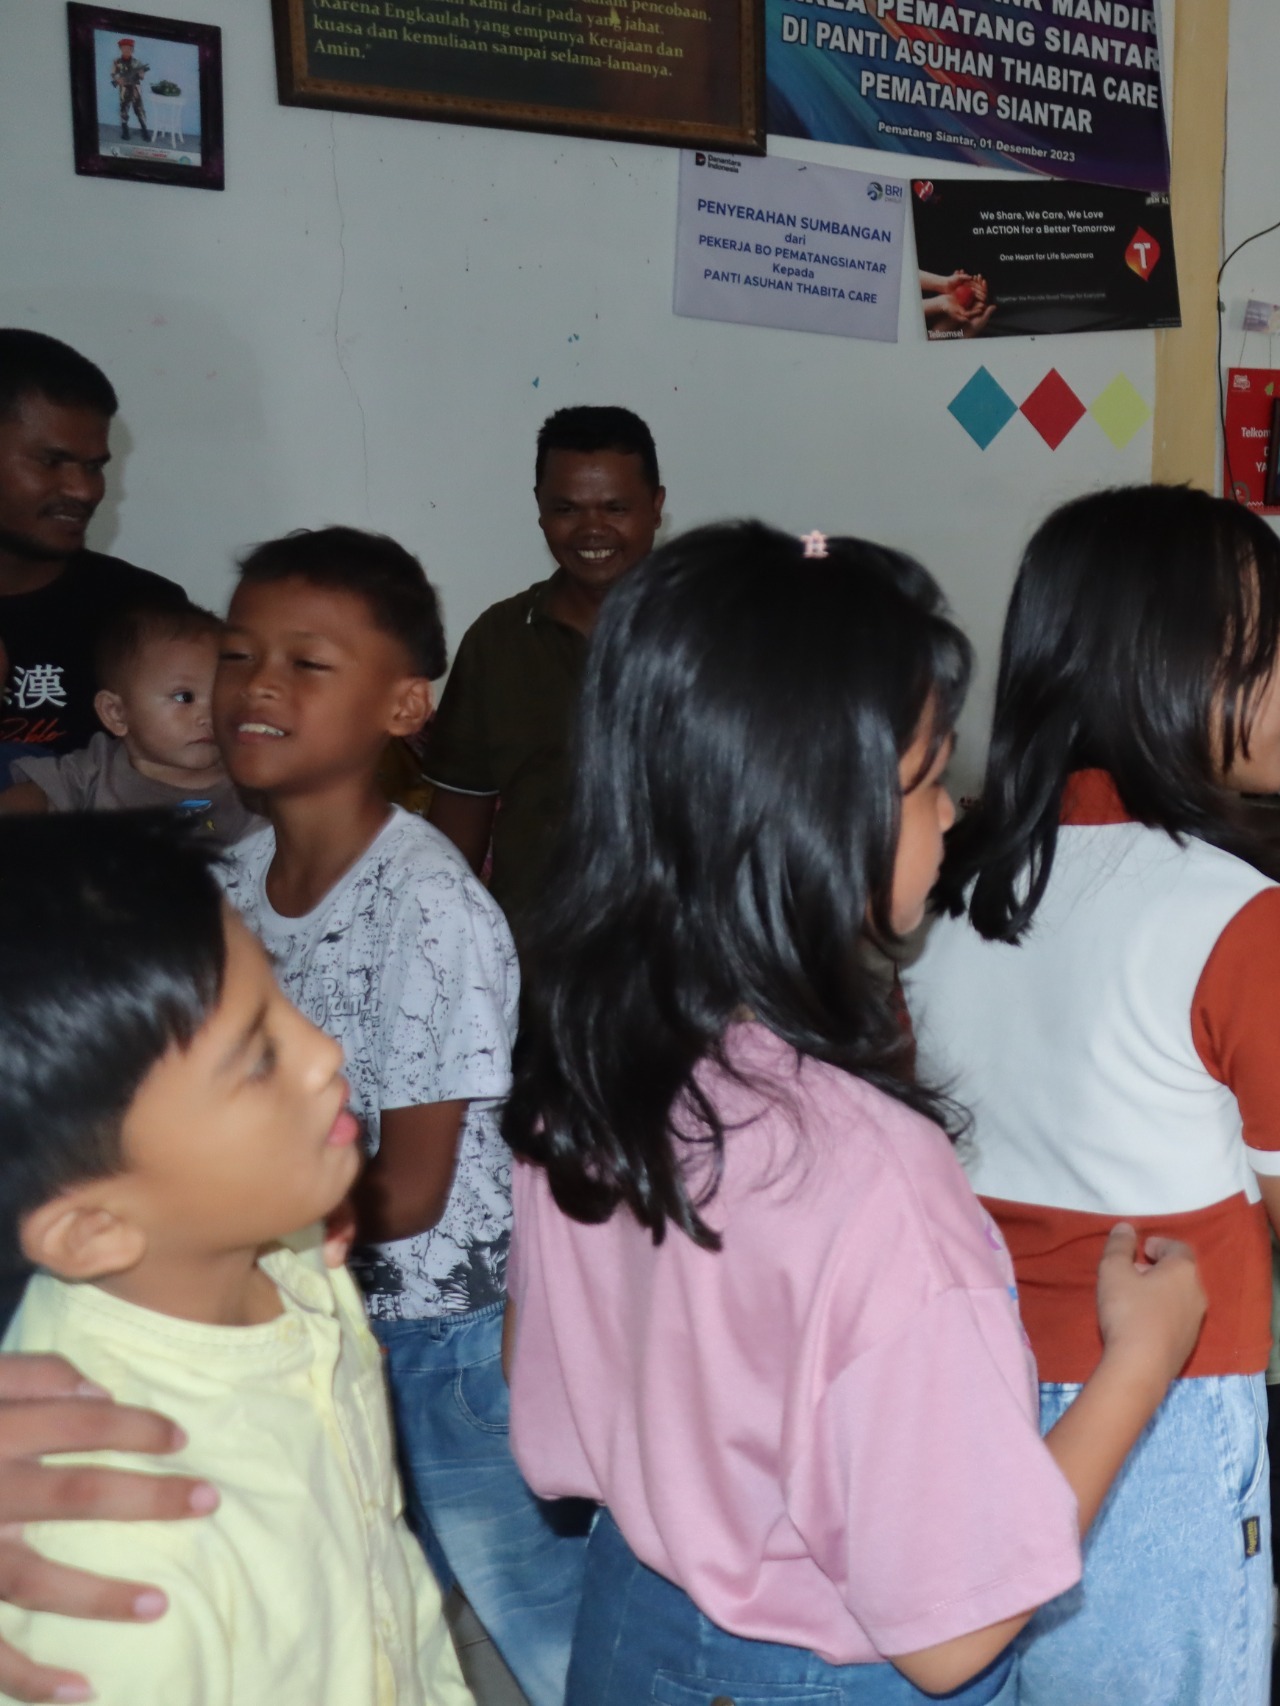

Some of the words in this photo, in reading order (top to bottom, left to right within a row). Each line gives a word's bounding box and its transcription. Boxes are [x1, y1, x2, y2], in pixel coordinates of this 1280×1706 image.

[385, 3, 470, 29] Engkaulah
[474, 19, 511, 37] yang
[514, 24, 585, 46] empunya
[589, 31, 653, 54] Kerajaan
[656, 42, 684, 58] dan
[512, 0, 542, 17] dari
[546, 8, 583, 23] pada
[587, 14, 622, 31] yang
[1052, 0, 1157, 35] MANDIR
[313, 15, 363, 36] kuasa
[367, 23, 398, 40] dan
[402, 26, 488, 52] kemuliaan
[492, 41, 546, 61] sampai
[550, 49, 673, 78] selama-lamanya.
[876, 0, 1036, 47] PEMATANG
[1044, 26, 1162, 72] SIANTAR
[782, 14, 808, 45] DI
[816, 21, 888, 60] PANTI
[895, 37, 994, 79] ASUHAN
[1001, 57, 1097, 98] THABITA
[1103, 76, 1159, 109] CARE
[860, 69, 989, 116] PEMATANG
[996, 94, 1093, 134] SIANTAR
[878, 121, 933, 142] Pematang
[935, 130, 977, 148] Siantar,
[979, 137, 993, 149] 01
[995, 140, 1047, 158] Desember
[1050, 149, 1076, 162] 2023
[707, 154, 742, 167] Danantara
[707, 160, 739, 174] Indonesia
[884, 184, 903, 198] BRI
[697, 198, 797, 228] PENYERAHAN
[800, 216, 892, 243] SUMBANGAN
[972, 226, 985, 235] an
[986, 225, 1020, 235] ACTION
[1021, 224, 1035, 234] for
[1035, 226, 1042, 234] a
[1043, 224, 1070, 234] Better
[1071, 224, 1116, 234] Tomorrow
[980, 211, 995, 220] We
[996, 210, 1025, 221] Share,
[1025, 210, 1041, 220] We
[1042, 210, 1066, 221] Care,
[1067, 210, 1082, 219] We
[1083, 210, 1104, 219] Love
[698, 234, 751, 253] PEKERJA
[755, 243, 772, 256] BO
[775, 246, 887, 275] PEMATANGSIANTAR
[784, 232, 806, 246] dari
[772, 262, 815, 279] Kepada
[999, 253, 1014, 262] One
[1015, 252, 1035, 261] Heart
[1035, 252, 1046, 261] for
[1046, 252, 1059, 260] Life
[1060, 251, 1094, 260] Sumatera
[703, 268, 741, 284] PANTI
[743, 274, 793, 292] ASUHAN
[796, 282, 846, 300] THABITA
[848, 290, 878, 304] CARE
[927, 329, 964, 338] Telkomsel
[1241, 427, 1271, 438] Telkom
[3, 664, 67, 709] 漢
